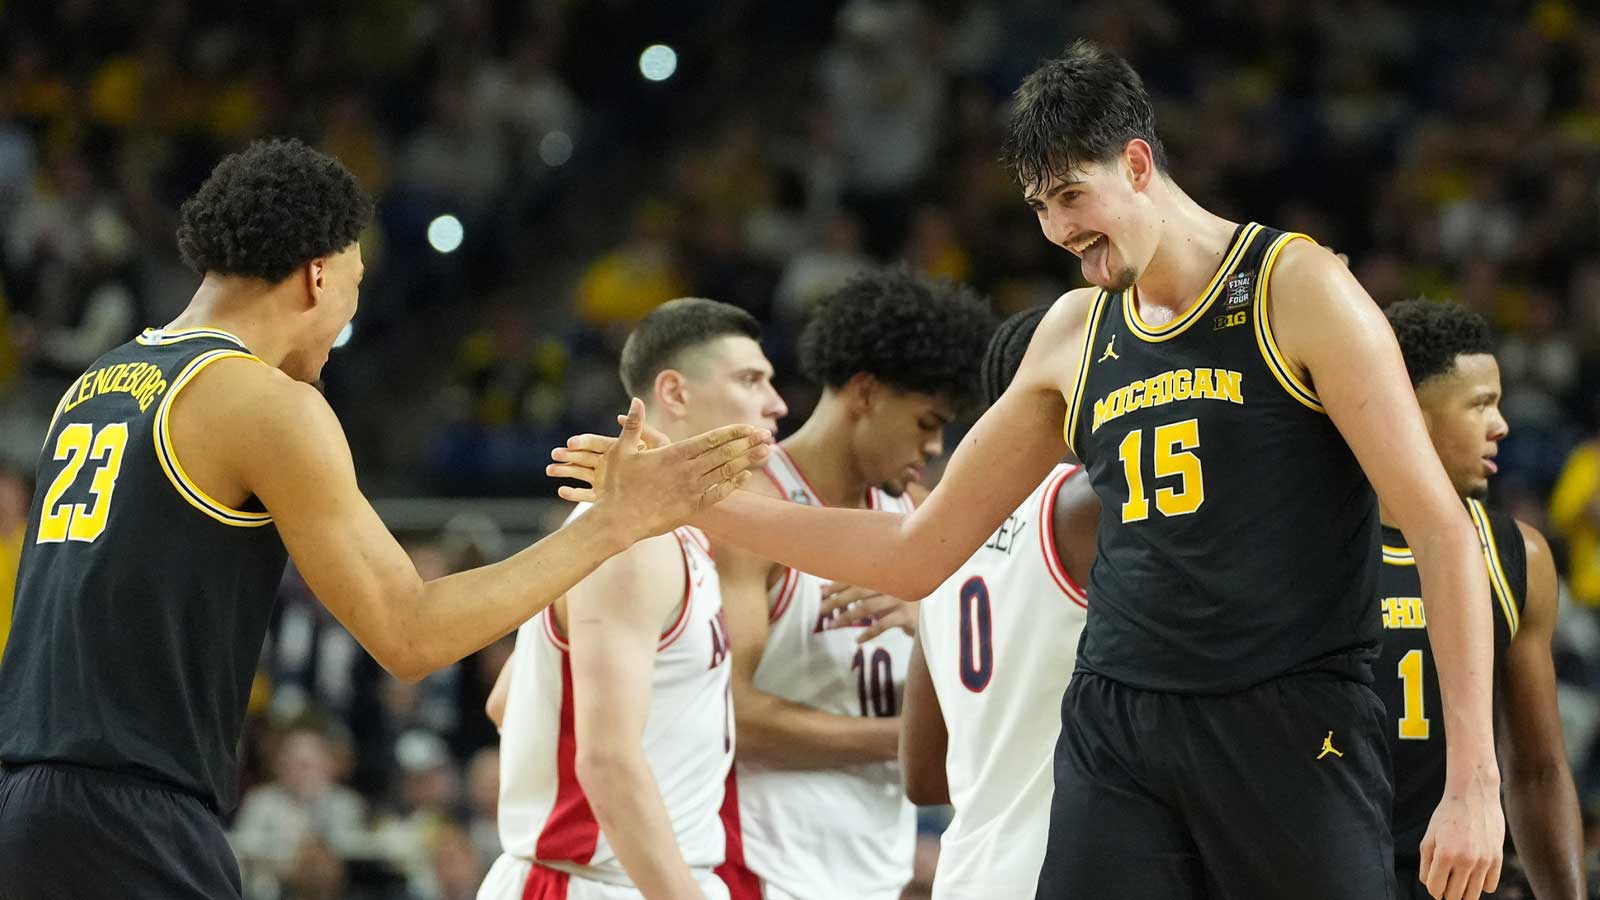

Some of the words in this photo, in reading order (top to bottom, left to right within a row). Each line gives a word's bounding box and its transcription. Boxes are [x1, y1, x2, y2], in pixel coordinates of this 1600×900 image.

[1228, 293, 1249, 304] FOUR
[64, 362, 167, 414] LENDEBORG
[1091, 368, 1244, 434] MICHIGAN
[36, 422, 129, 544] 23
[1119, 418, 1205, 524] 15
[960, 575, 993, 693] 0
[851, 646, 897, 718] 10
[1398, 649, 1430, 740] 1
